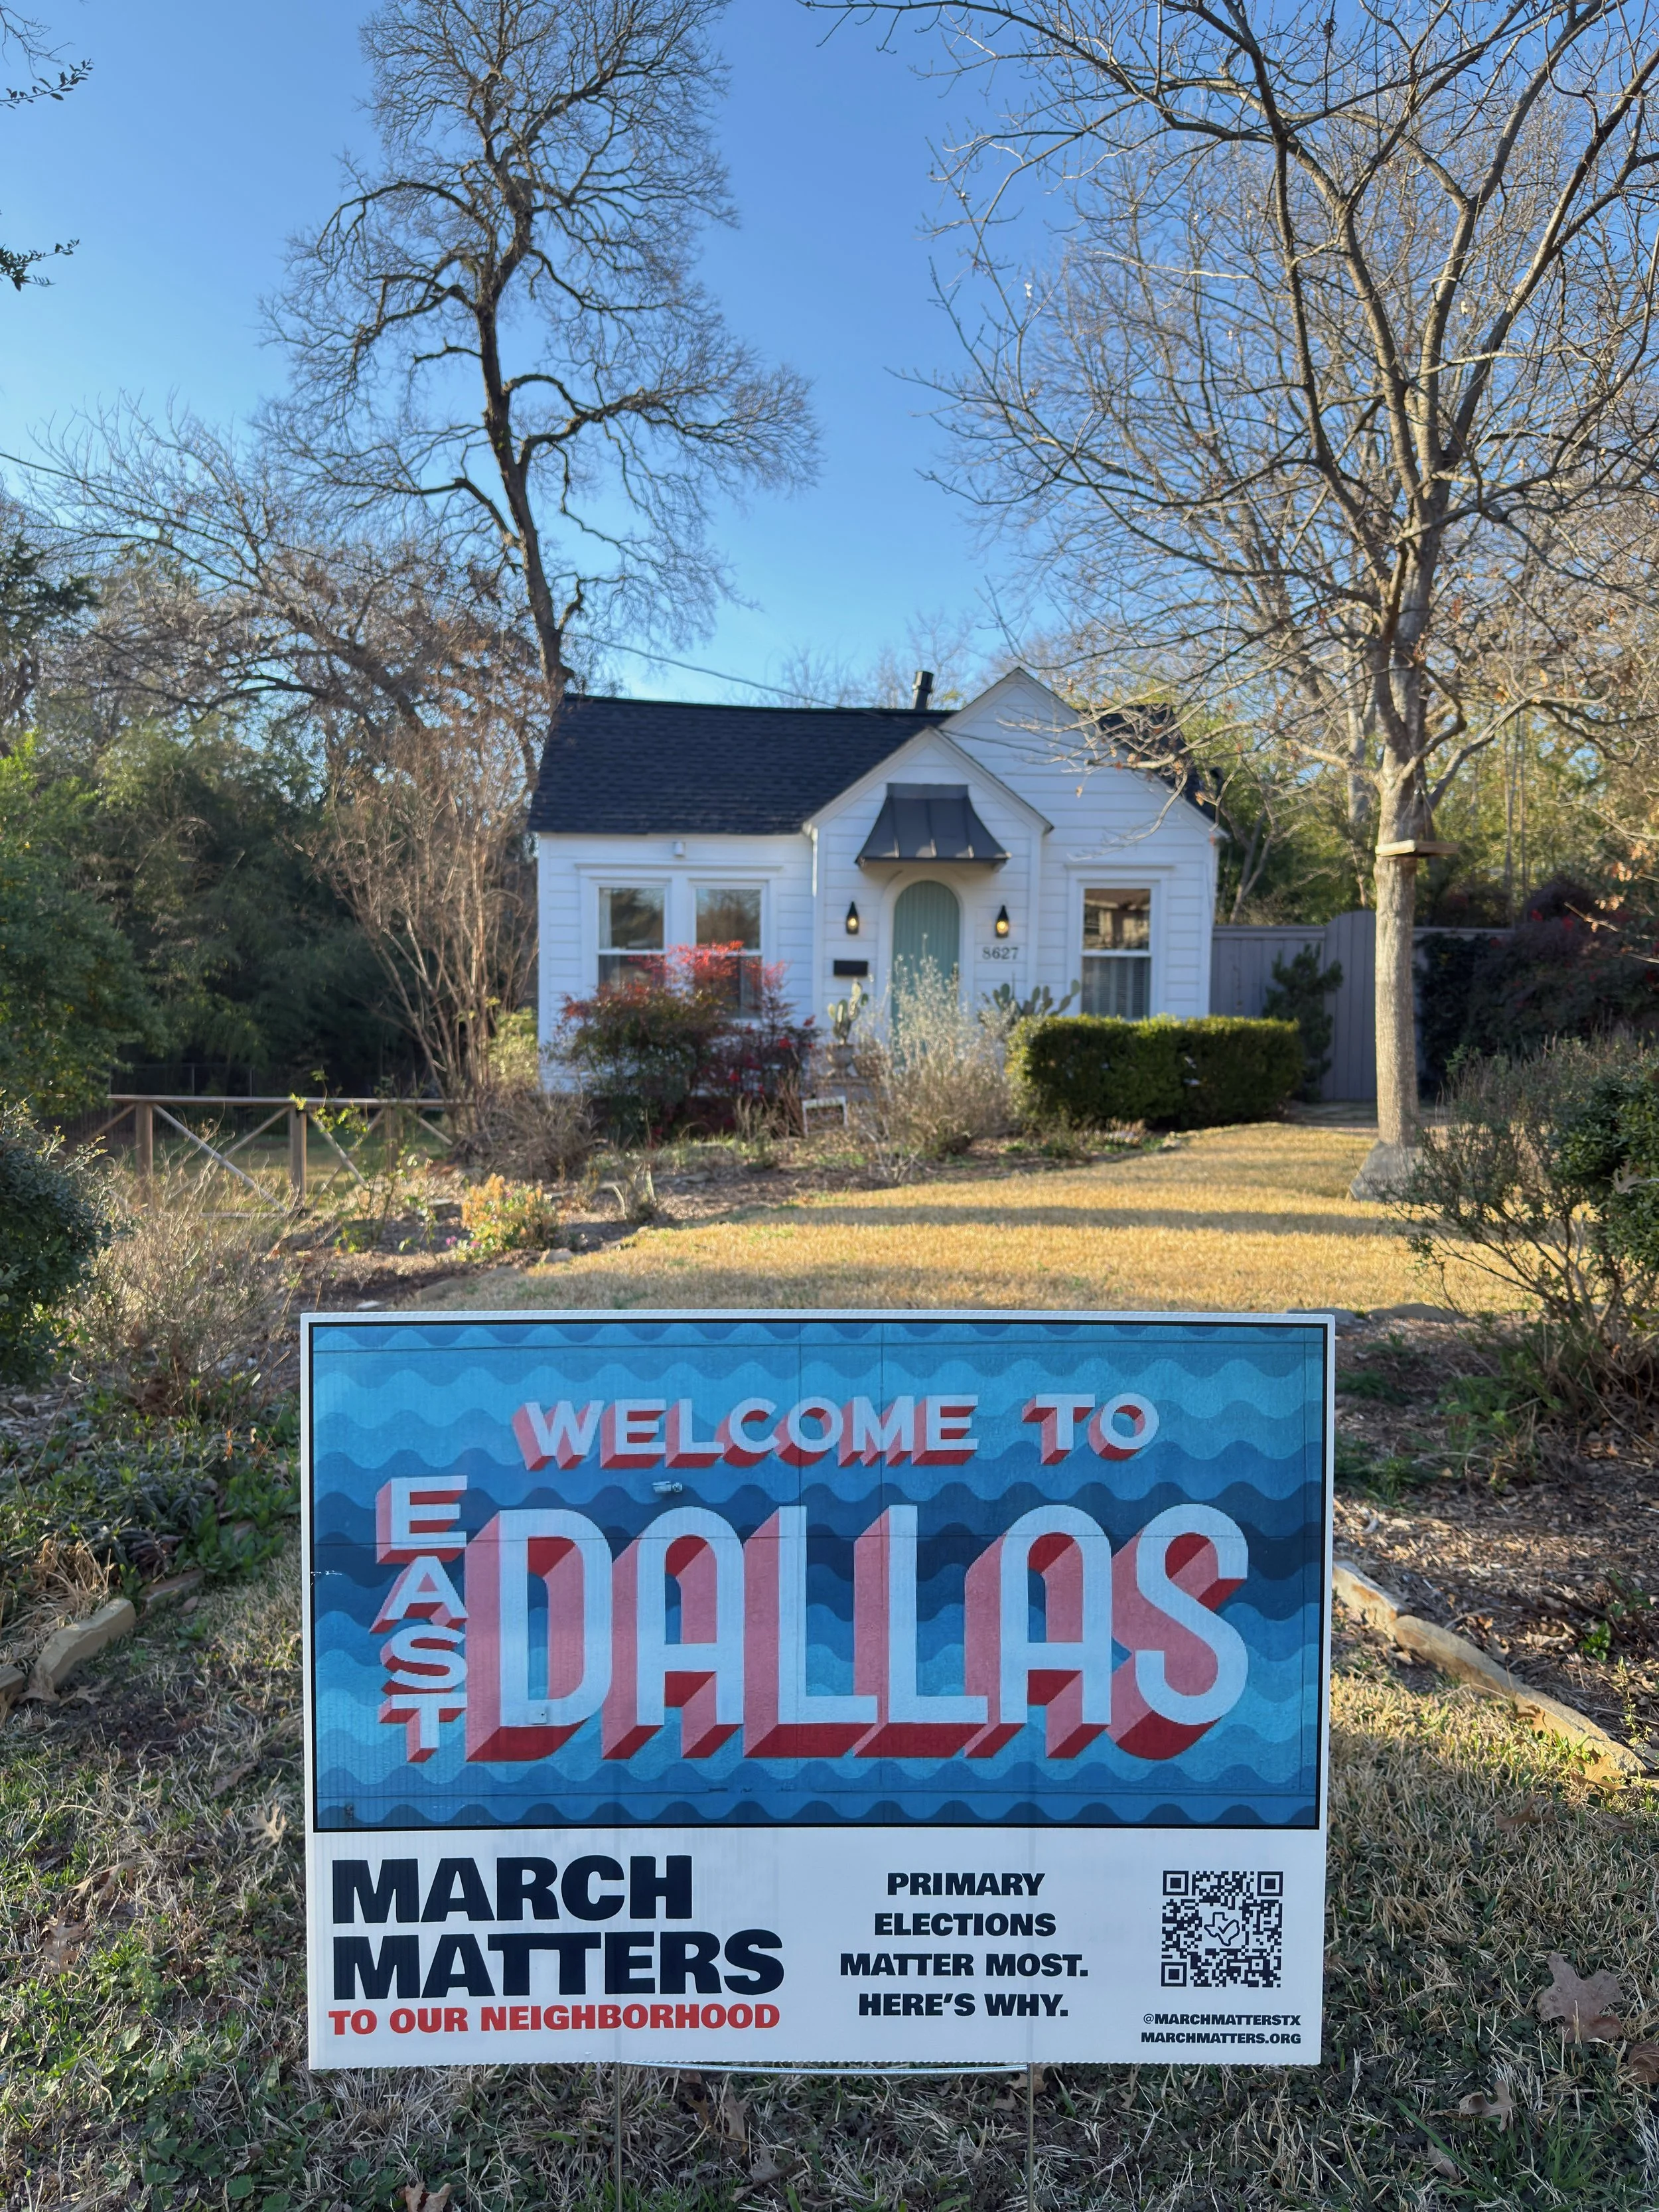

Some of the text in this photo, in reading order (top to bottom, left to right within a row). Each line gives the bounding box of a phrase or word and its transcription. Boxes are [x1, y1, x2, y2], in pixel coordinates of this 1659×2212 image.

[982, 947, 1019, 960] 8627
[512, 1393, 1159, 1471] WELCOME TO
[369, 1475, 469, 1763] EAST
[466, 1503, 1249, 1762] DALLAS
[332, 1855, 692, 1924] MARCH
[887, 1872, 1046, 1896] PRIMARY
[875, 1913, 1056, 1937] ELECTIONS
[333, 1929, 785, 2000] MATTERS
[840, 1953, 1089, 1977] MATTER MOST.
[859, 1992, 1068, 2017] HERE'S WHY.
[328, 2003, 780, 2035] TO OUR NEIGHBORHOOD
[1143, 2014, 1301, 2026] @MARCHMATTERSTX
[1141, 2032, 1301, 2044] MARCHMATTERS.ORG
